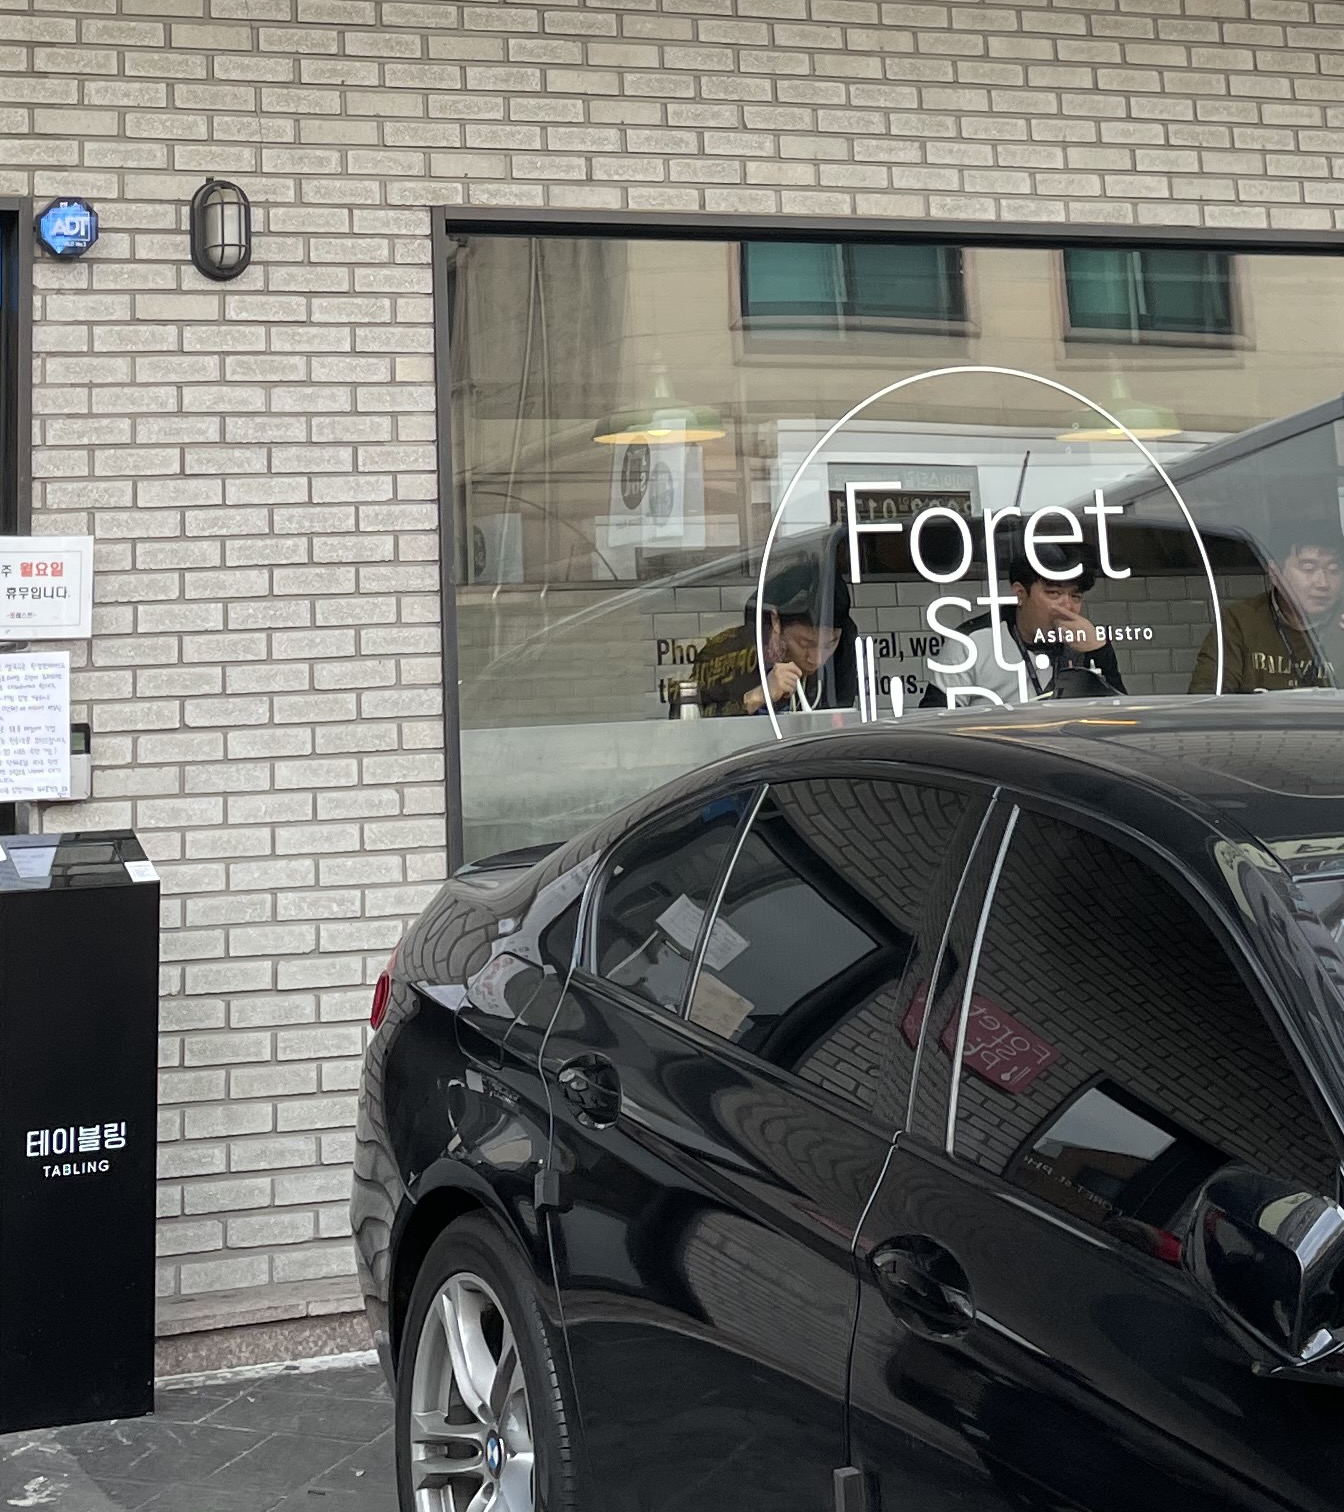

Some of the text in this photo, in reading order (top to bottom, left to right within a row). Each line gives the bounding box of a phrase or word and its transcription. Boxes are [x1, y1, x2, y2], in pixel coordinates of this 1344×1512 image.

[51, 216, 87, 236] ADT
[844, 480, 1133, 584] Foret
[19, 561, 64, 578] 월요일
[925, 595, 1051, 675] st.
[1034, 625, 1154, 645] Asian Bistro
[25, 1121, 126, 1157] 테이블링
[42, 1159, 110, 1178] TABLING
